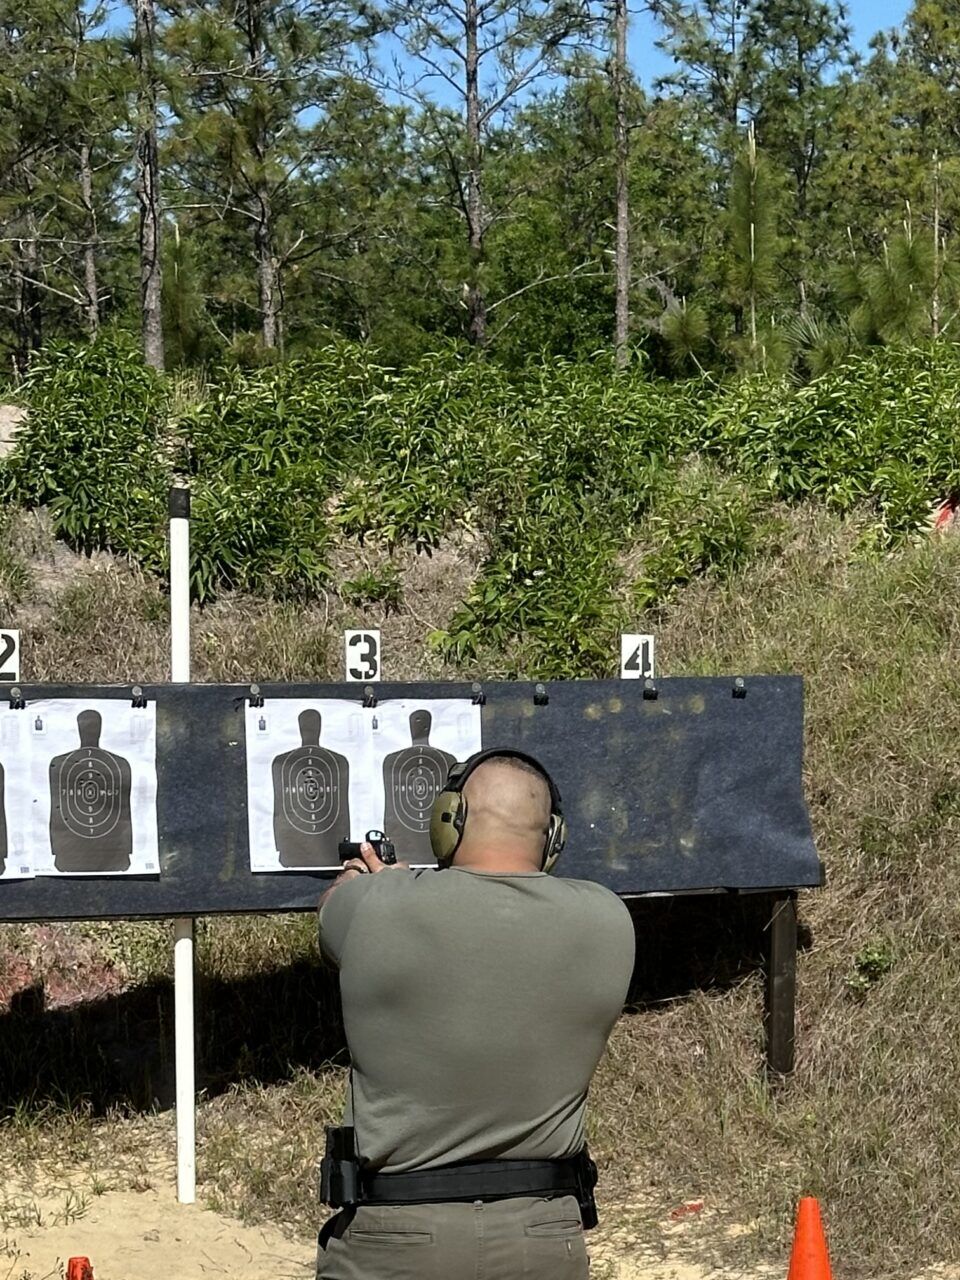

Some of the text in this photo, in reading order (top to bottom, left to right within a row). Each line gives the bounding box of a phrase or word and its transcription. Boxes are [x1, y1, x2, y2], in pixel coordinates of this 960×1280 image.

[0, 633, 16, 681] 2
[349, 634, 378, 680] 3
[624, 640, 652, 679] 4
